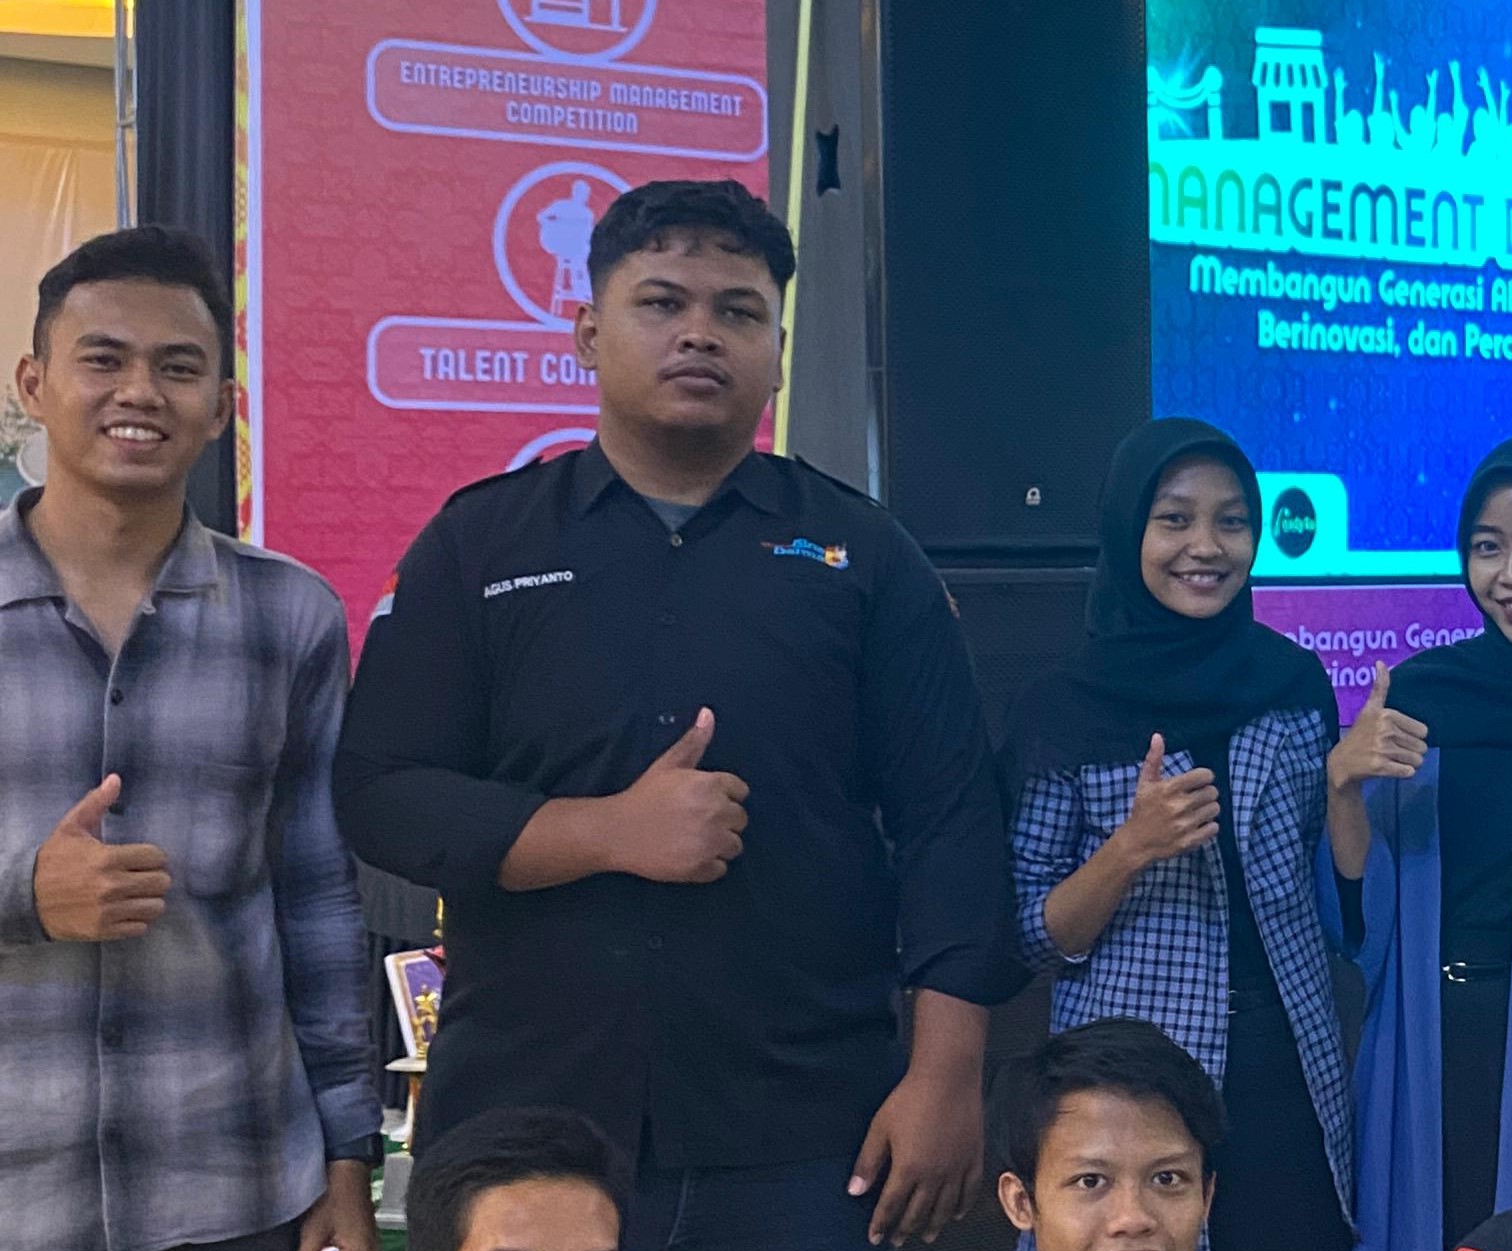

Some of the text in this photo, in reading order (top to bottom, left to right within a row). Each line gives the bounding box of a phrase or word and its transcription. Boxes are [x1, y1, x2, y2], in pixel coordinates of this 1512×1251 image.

[400, 60, 743, 117] ENTREPRENEURSHIP MANAGEMENT
[506, 100, 638, 134] COMPETITION
[1189, 253, 1371, 311] Membangun
[1378, 269, 1485, 313] Generasi
[1257, 308, 1401, 358] Berinovasi,
[1407, 319, 1458, 358] dan
[419, 346, 529, 383] TALENT
[484, 570, 573, 598] AGUS PRIYANTO
[1284, 624, 1398, 657] bangun
